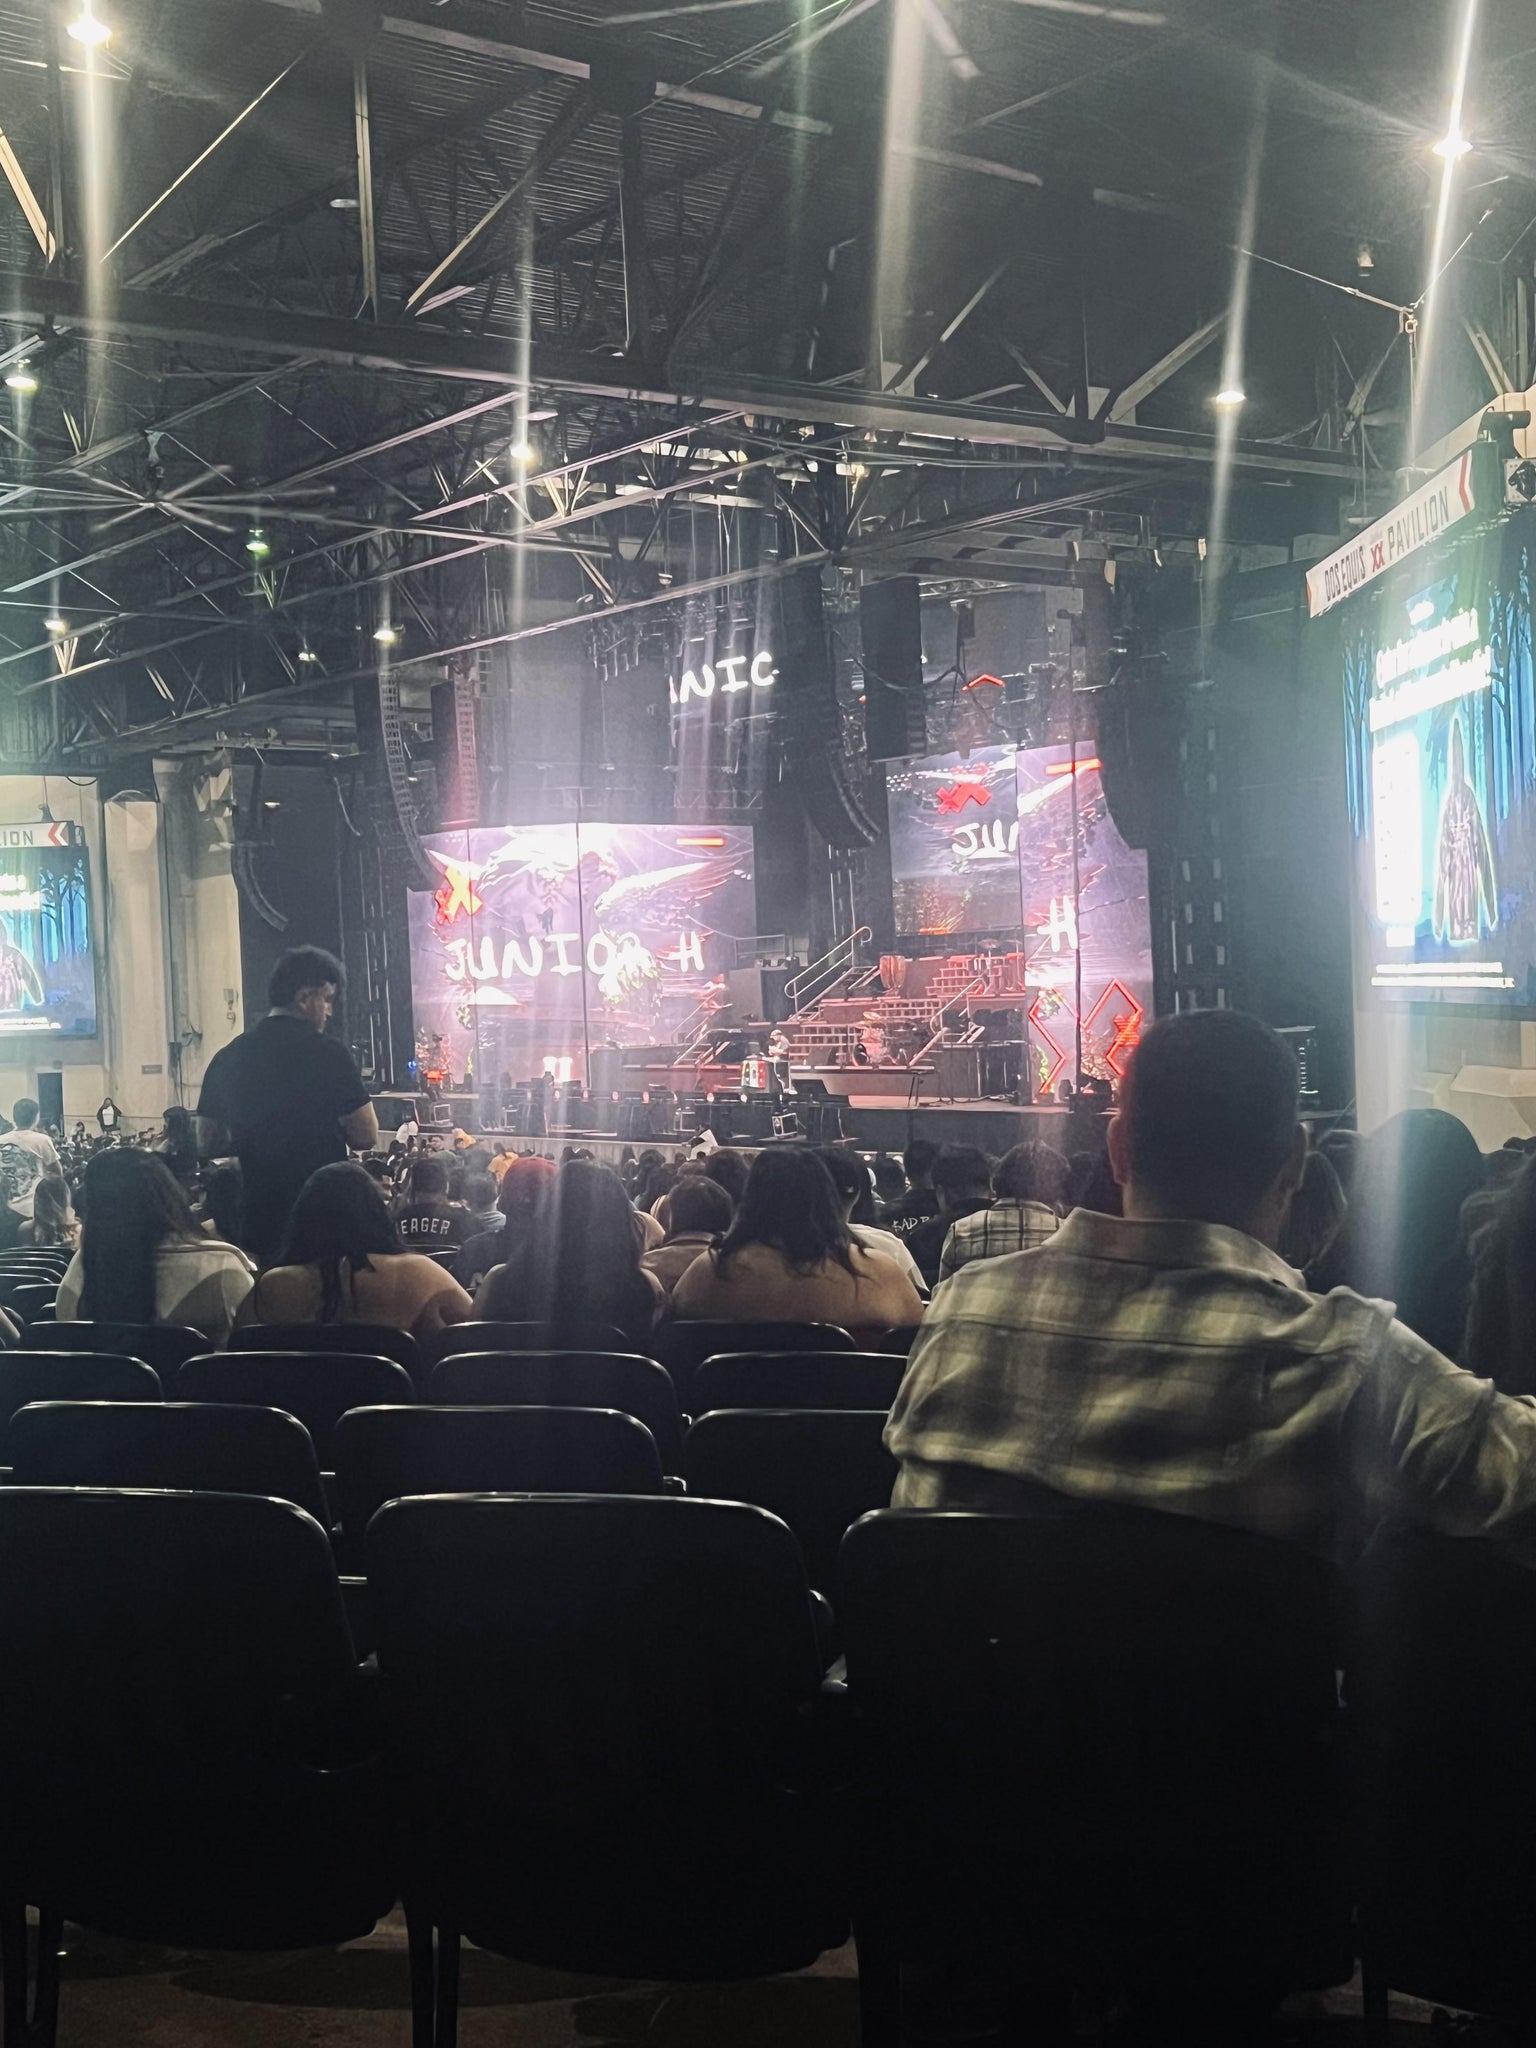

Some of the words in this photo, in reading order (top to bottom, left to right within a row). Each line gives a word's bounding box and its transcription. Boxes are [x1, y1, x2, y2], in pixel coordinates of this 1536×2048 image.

[1324, 562, 1341, 602] DOS
[1341, 545, 1366, 591] EQUIS
[1387, 486, 1449, 561] PAVILION
[667, 931, 704, 972] H
